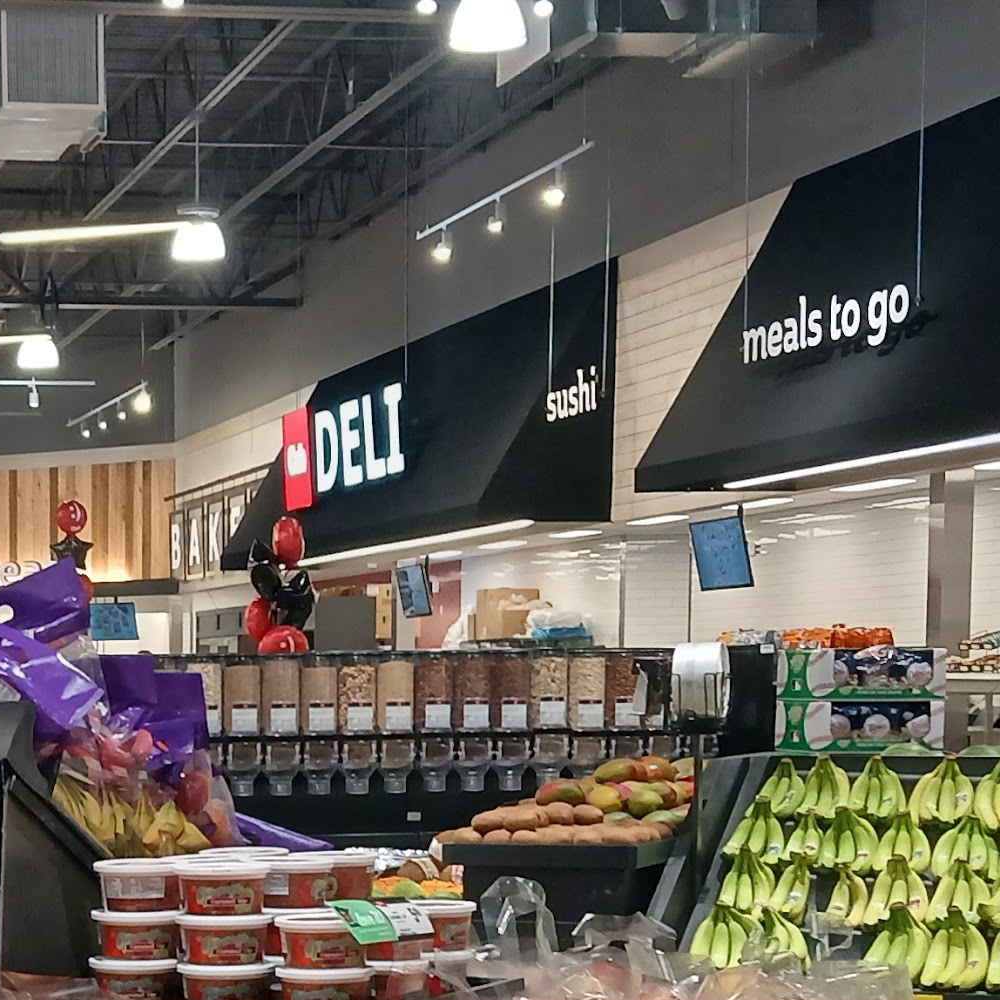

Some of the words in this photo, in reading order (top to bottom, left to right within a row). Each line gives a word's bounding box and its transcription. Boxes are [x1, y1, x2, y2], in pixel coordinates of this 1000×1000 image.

[743, 295, 823, 364] meals
[830, 294, 861, 341] to
[867, 284, 910, 346] go
[546, 365, 597, 423] sushi
[314, 382, 405, 493] DELI
